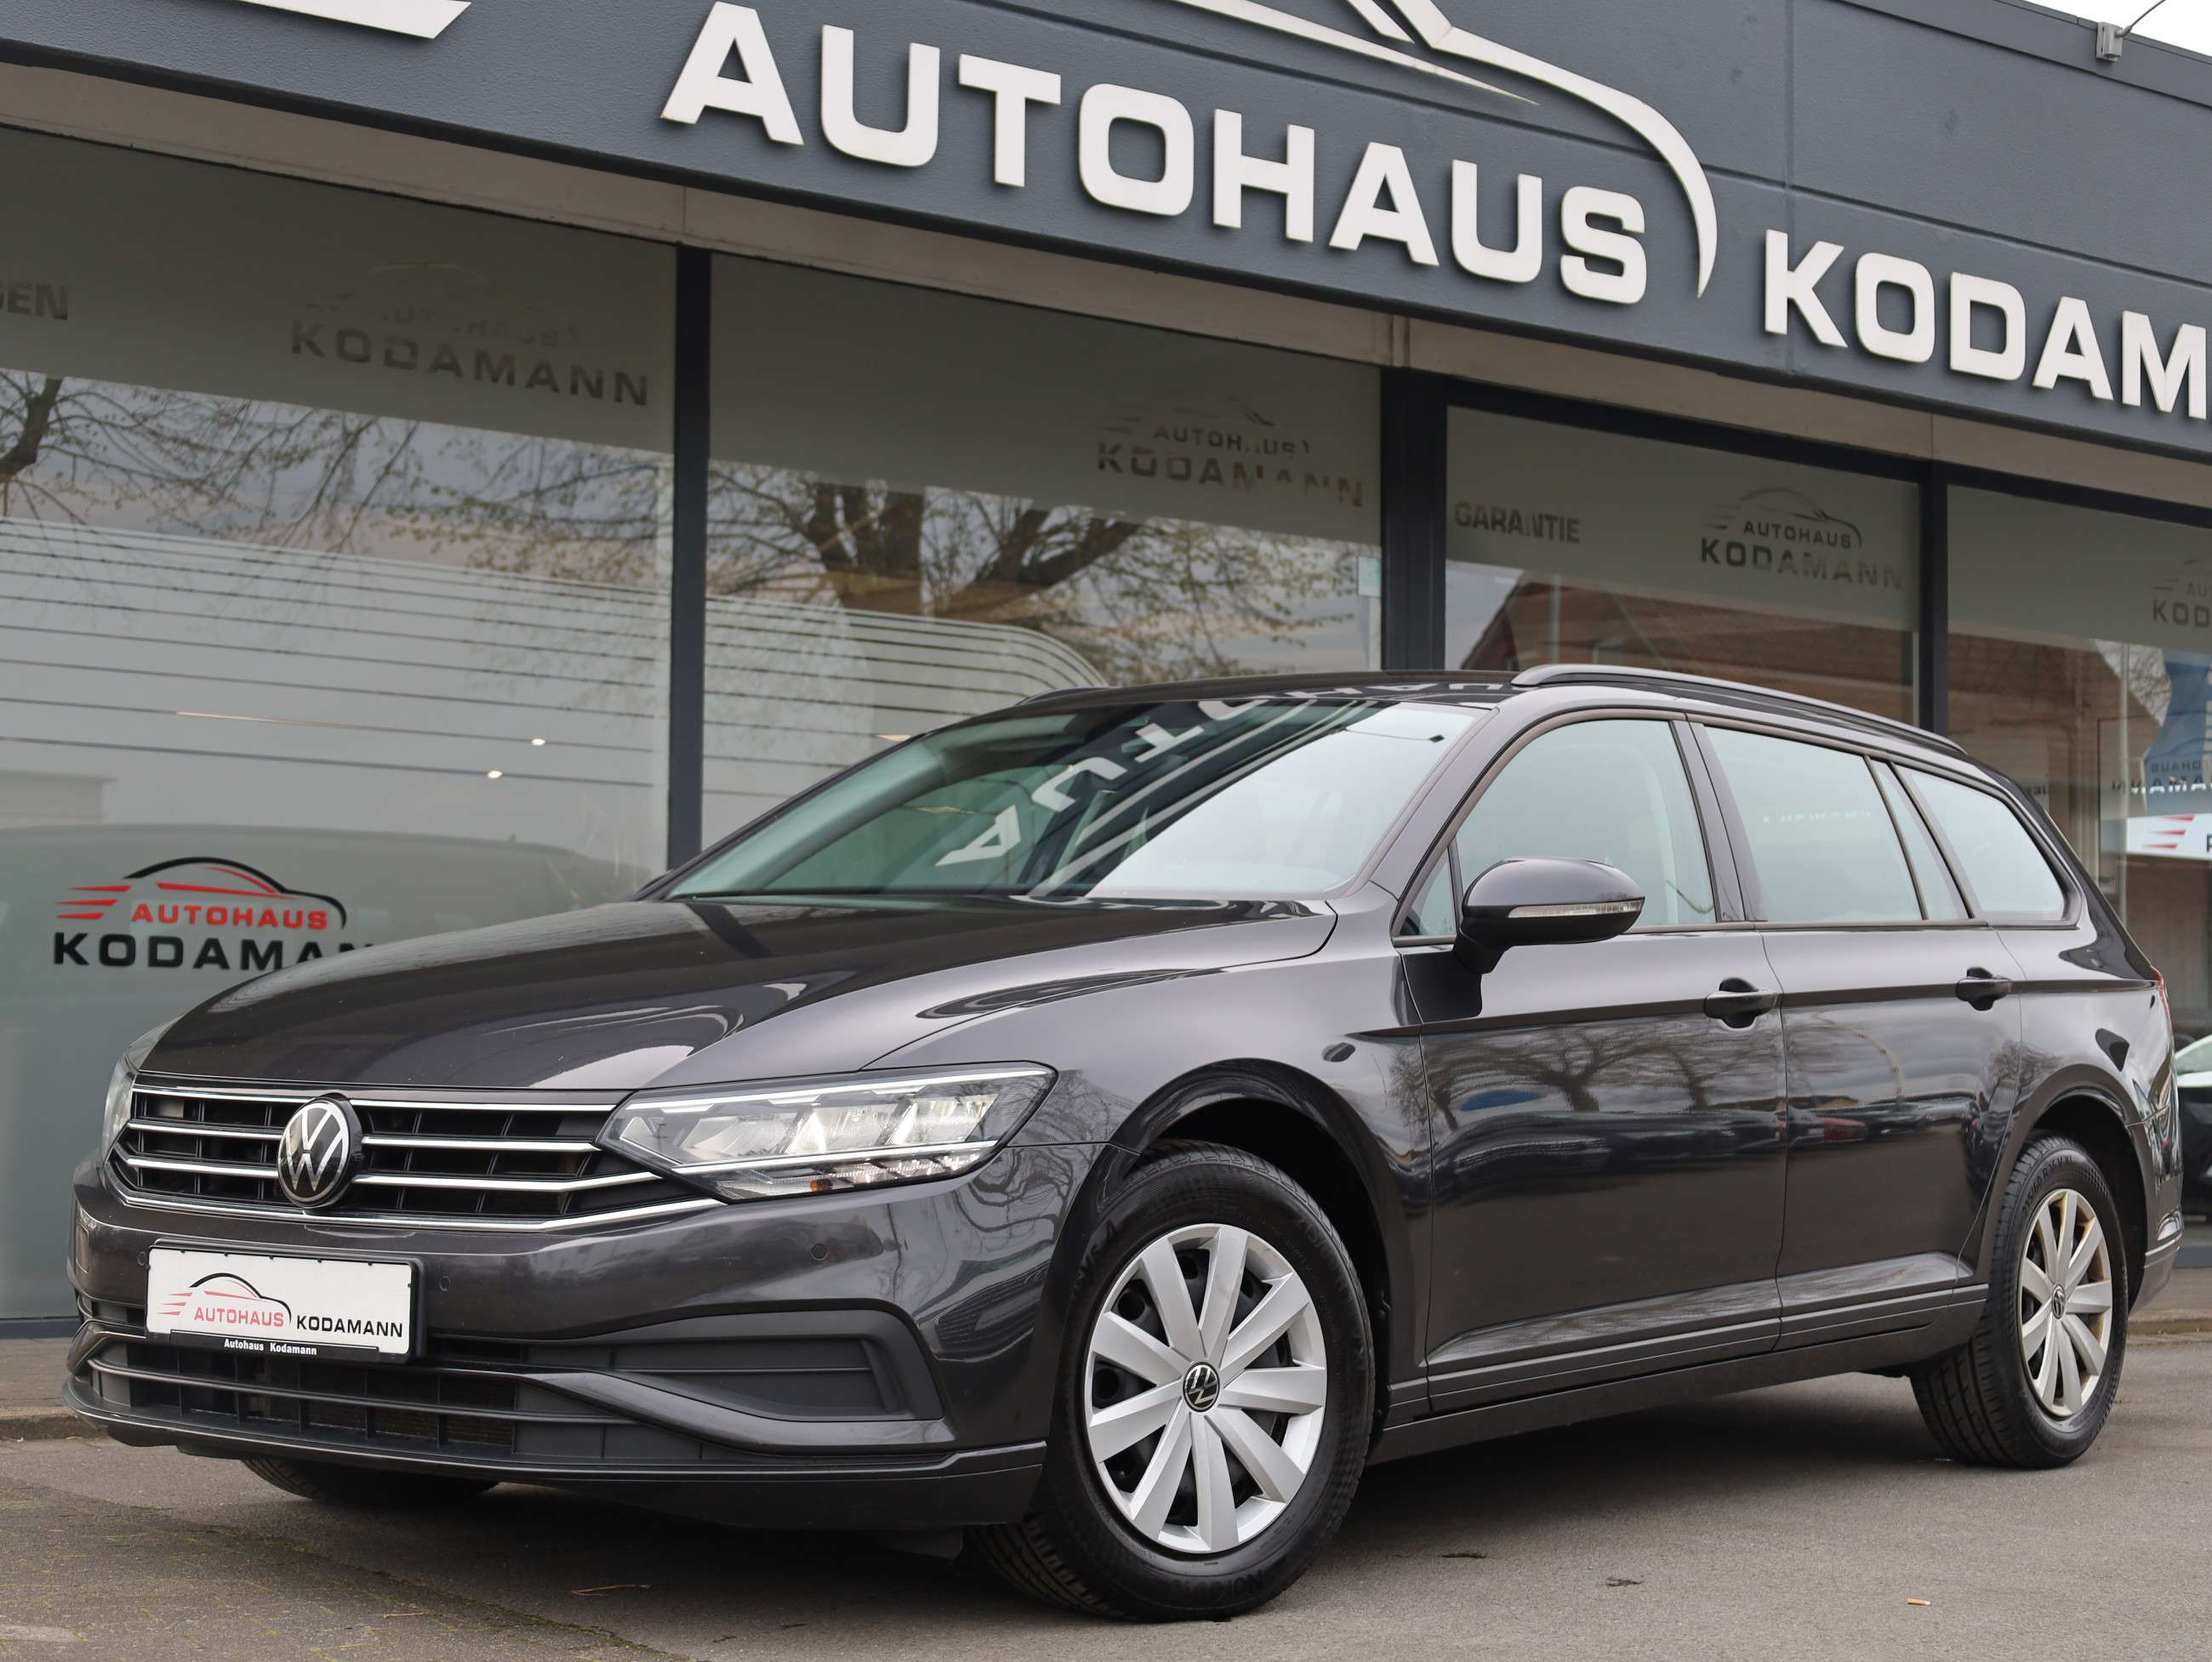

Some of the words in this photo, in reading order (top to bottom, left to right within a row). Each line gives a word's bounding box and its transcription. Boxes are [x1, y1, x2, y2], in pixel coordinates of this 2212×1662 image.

[660, 1, 1647, 304] AUTOHAUS
[1765, 229, 2207, 419] KODAM
[0, 280, 68, 321] EN
[291, 320, 648, 407] KODAMANN
[1154, 424, 1296, 458] AUTOHUS
[1454, 500, 1581, 544] GARANTIE
[1744, 521, 1851, 549] AUTOHAUS
[1702, 537, 1904, 589] KODAMANN
[133, 903, 328, 930] AUTOHAUS
[54, 932, 374, 971] KODAMA
[194, 1306, 285, 1327] AUTOHAUS
[297, 1315, 403, 1338] KODAMANN
[224, 1338, 264, 1352] Autohaus
[270, 1342, 317, 1356] Kodamann
